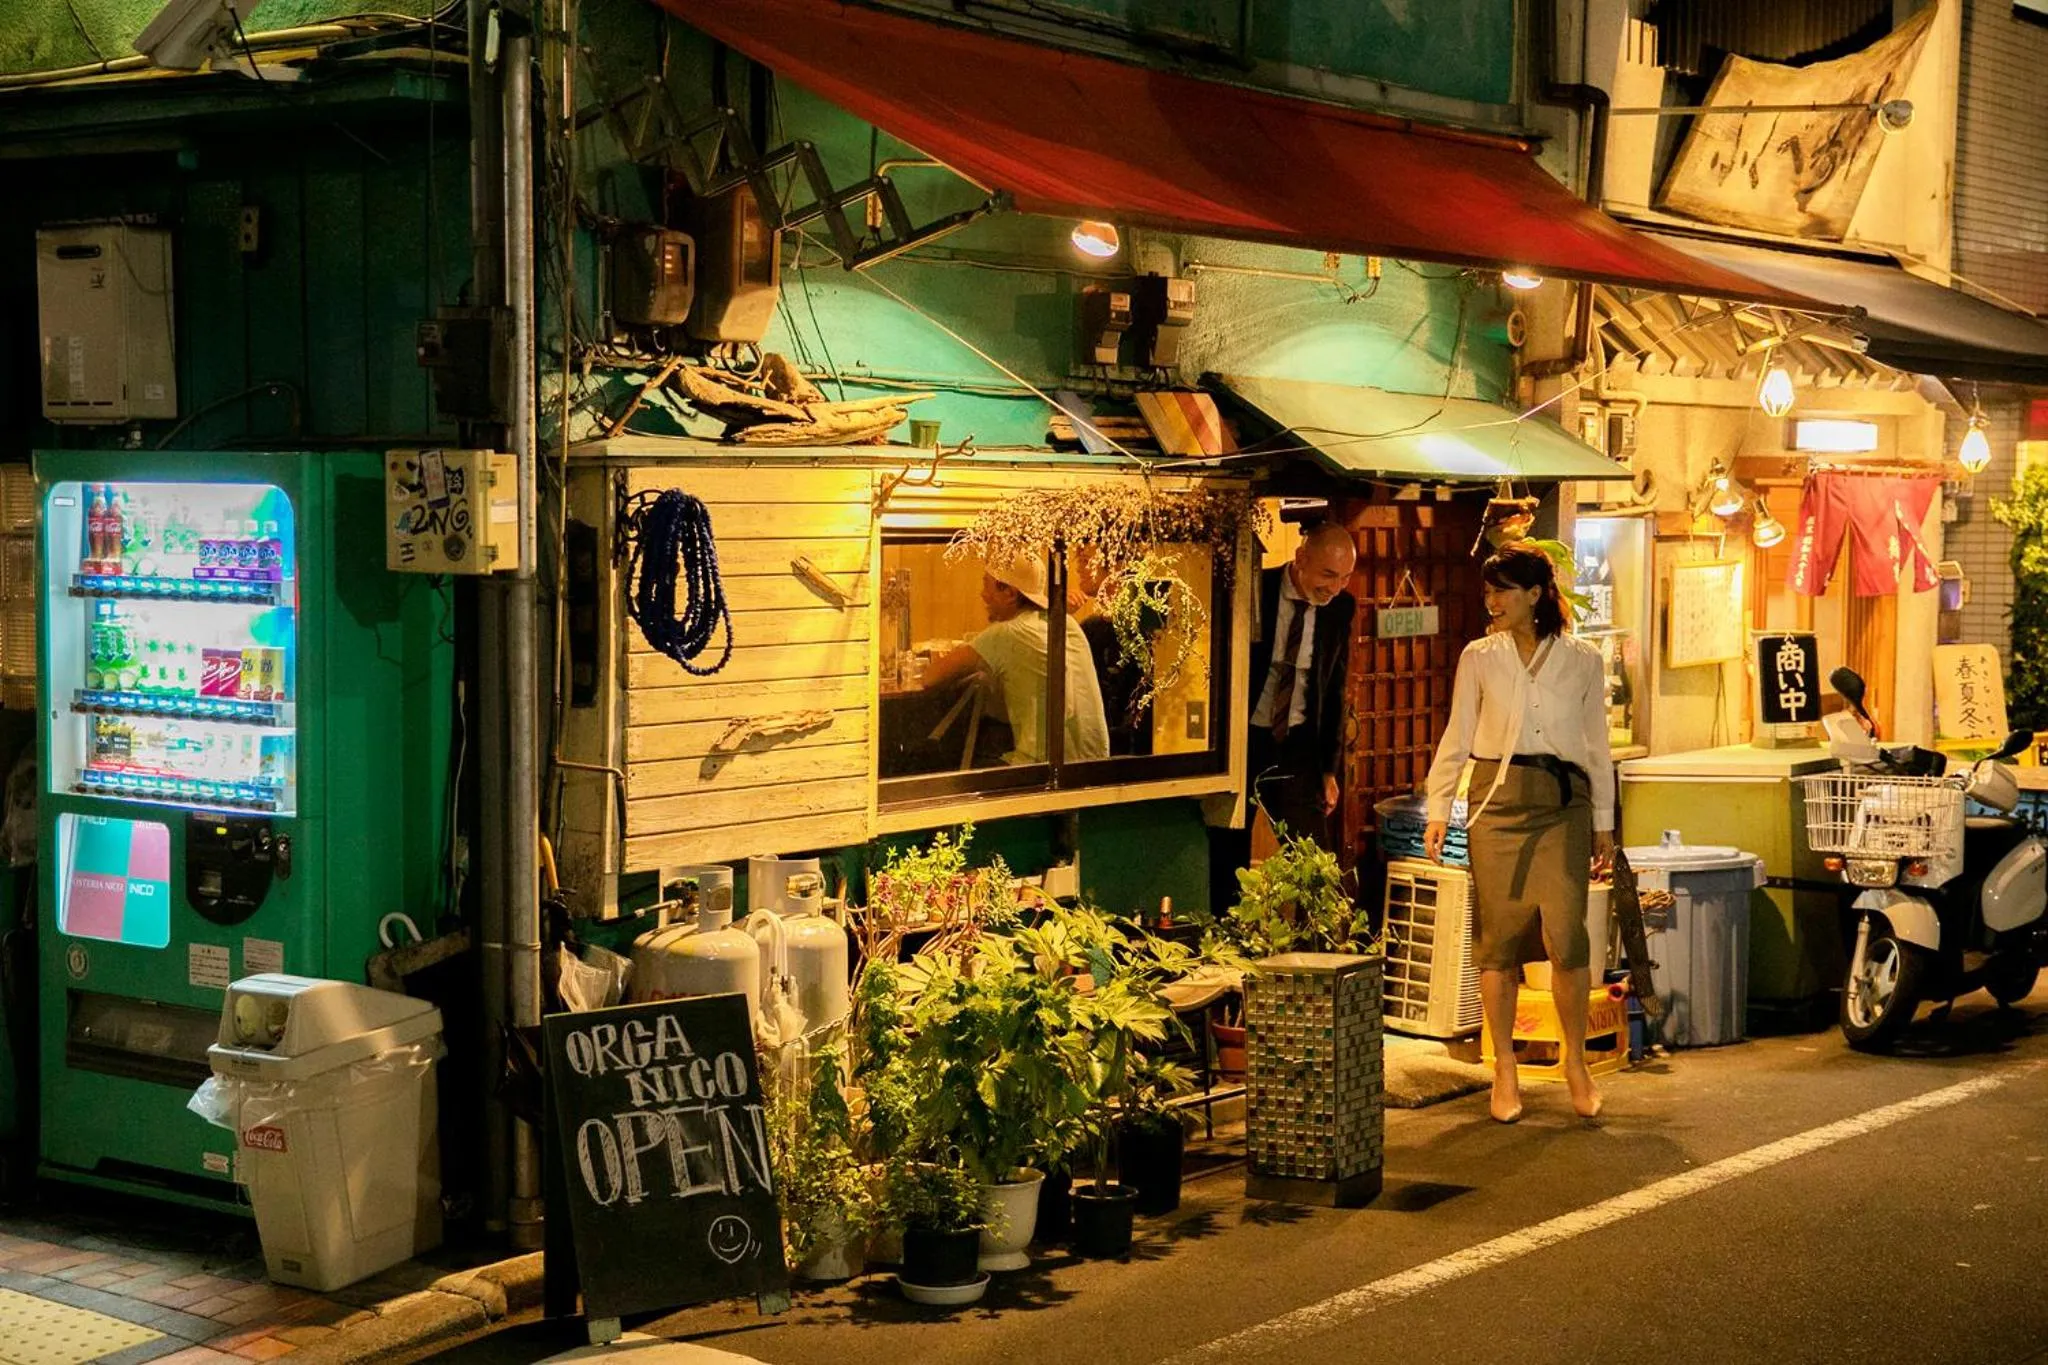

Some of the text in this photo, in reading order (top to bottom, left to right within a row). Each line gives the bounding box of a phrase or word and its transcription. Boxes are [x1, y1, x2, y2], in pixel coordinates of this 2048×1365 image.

[1385, 611, 1424, 633] OPEN
[1776, 641, 1807, 721] 商い中
[566, 1014, 696, 1079] ORGA
[624, 1052, 748, 1108] NICO
[245, 1127, 284, 1150] Coca-Cola
[576, 1103, 773, 1207] OPEN
